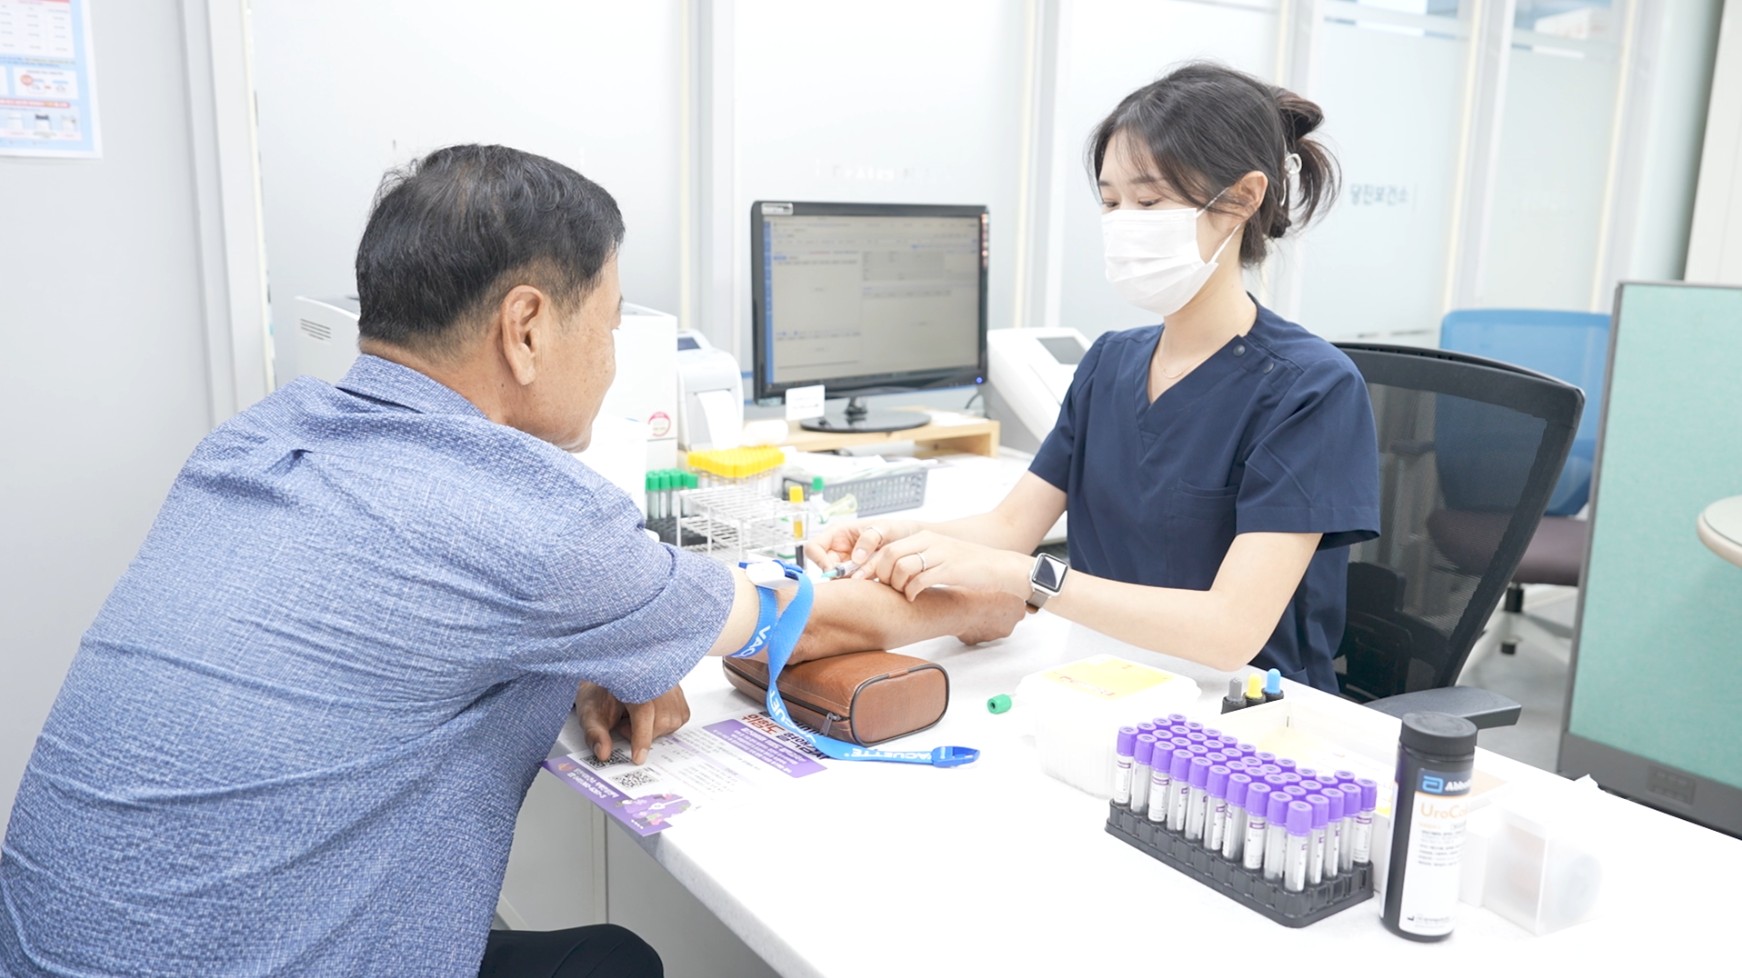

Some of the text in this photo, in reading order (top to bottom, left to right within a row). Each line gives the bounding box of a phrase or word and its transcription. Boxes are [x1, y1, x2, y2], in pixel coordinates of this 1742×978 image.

[1350, 183, 1408, 206] 당진보건소
[737, 624, 771, 658] VAC
[742, 713, 785, 735] 위험도
[1420, 802, 1468, 819] UroCo
